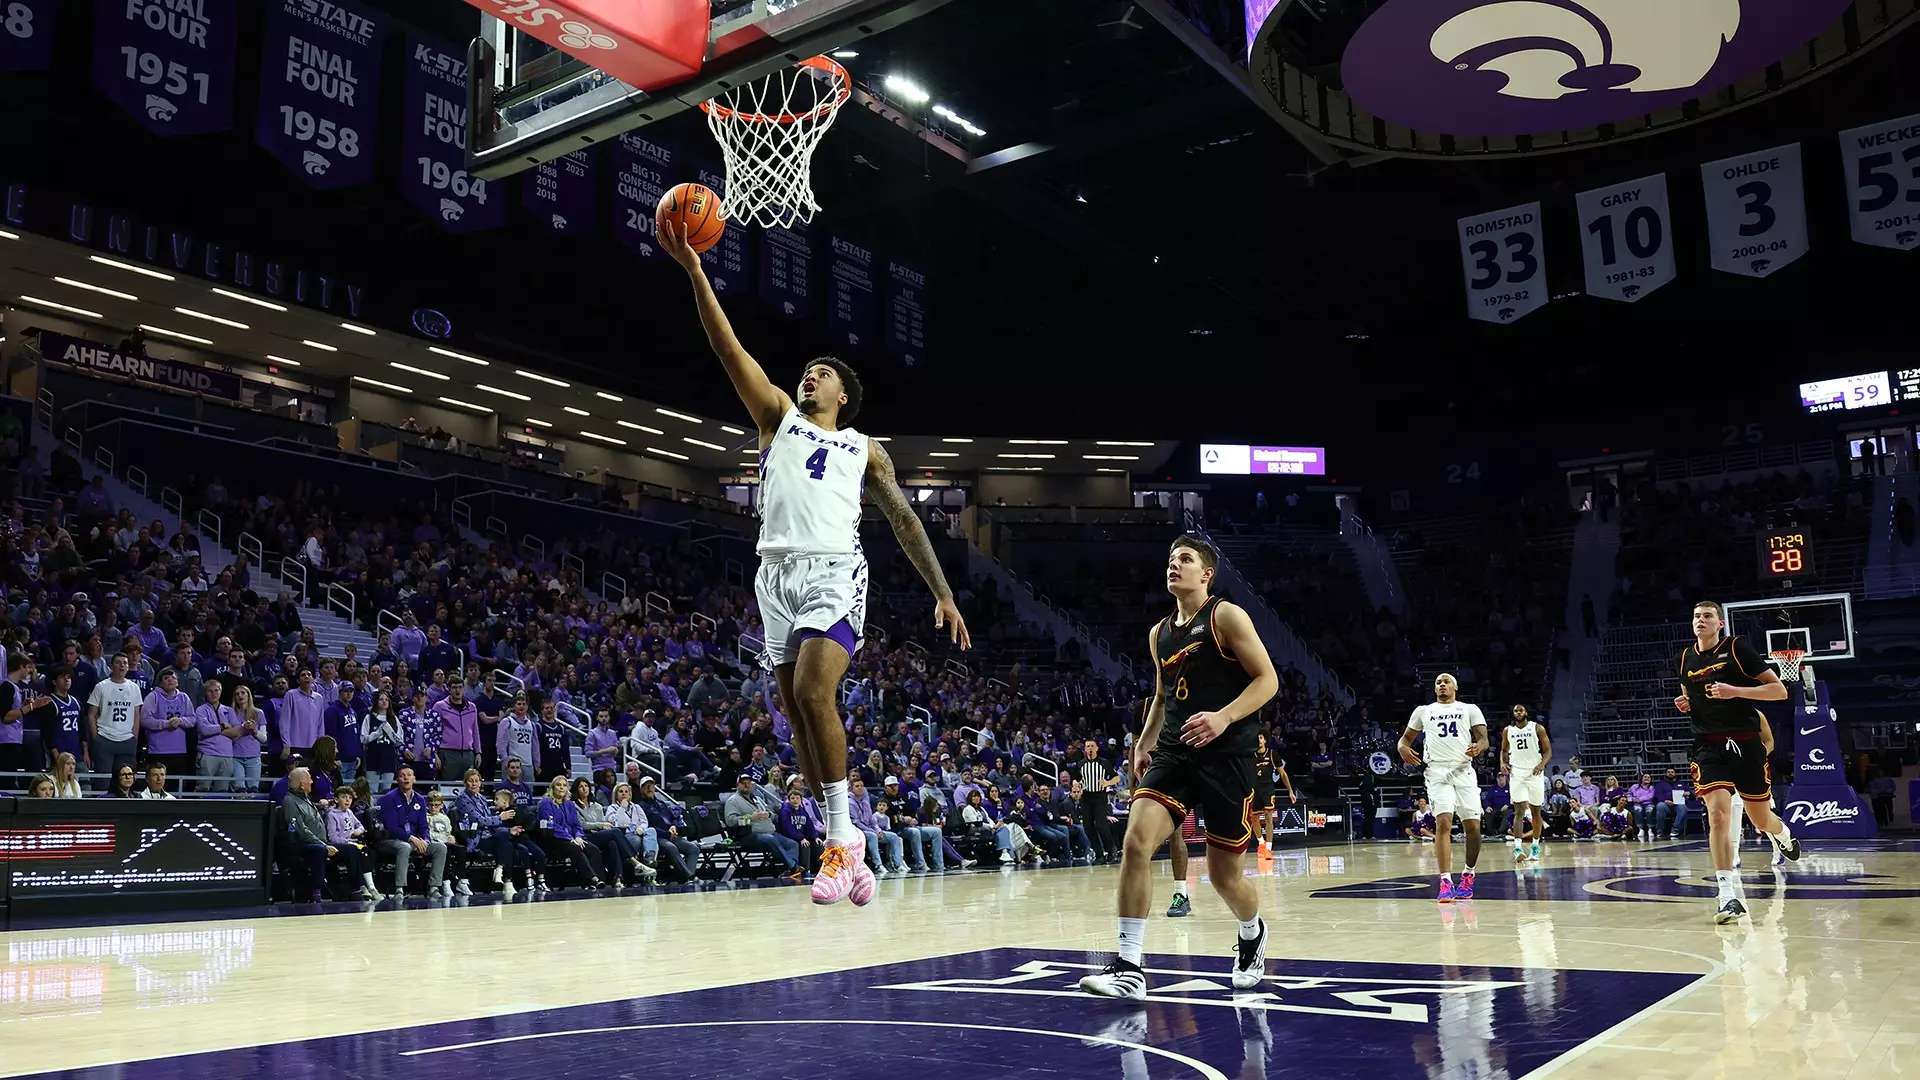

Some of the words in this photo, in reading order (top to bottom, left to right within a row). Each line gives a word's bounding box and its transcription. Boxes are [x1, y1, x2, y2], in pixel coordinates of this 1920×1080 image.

[125, 0, 209, 49] FOUR
[288, 35, 359, 85] FINAL
[120, 46, 210, 105] 1951
[285, 59, 356, 108] FOUR
[279, 105, 361, 159] 1958
[619, 132, 672, 163] K-STATE
[417, 156, 488, 206] 1964
[565, 162, 585, 177] 2023
[631, 162, 649, 179] BIG
[649, 171, 663, 185] 12
[1723, 157, 1781, 181] OHLDE
[536, 174, 558, 190] 2010
[536, 186, 558, 202] 2018
[1600, 188, 1642, 208] GARY
[1735, 180, 1776, 237] 3
[1466, 212, 1534, 237] ROMSTAD
[1587, 205, 1663, 267] 10
[832, 236, 873, 263] K-STATE
[1468, 231, 1538, 291] 33
[1731, 239, 1789, 259] 2000-04
[889, 260, 926, 287] K-STATE
[1605, 266, 1656, 285] 1981-83
[1482, 290, 1530, 308] 1979-82
[1854, 384, 1879, 402] 59
[787, 424, 862, 457] K-STATE
[805, 447, 829, 481] 4
[1766, 534, 1804, 548] 17:29
[1771, 549, 1802, 573] 28
[1175, 676, 1189, 700] 8
[63, 718, 79, 731] 24
[112, 708, 127, 722] 25
[1430, 713, 1464, 721] K-STATE
[517, 732, 530, 745] 23
[1437, 721, 1459, 738] 34
[548, 737, 561, 749] 24
[1516, 738, 1529, 750] 21
[1800, 763, 1836, 771] Channel
[1785, 800, 1859, 824] Dillons
